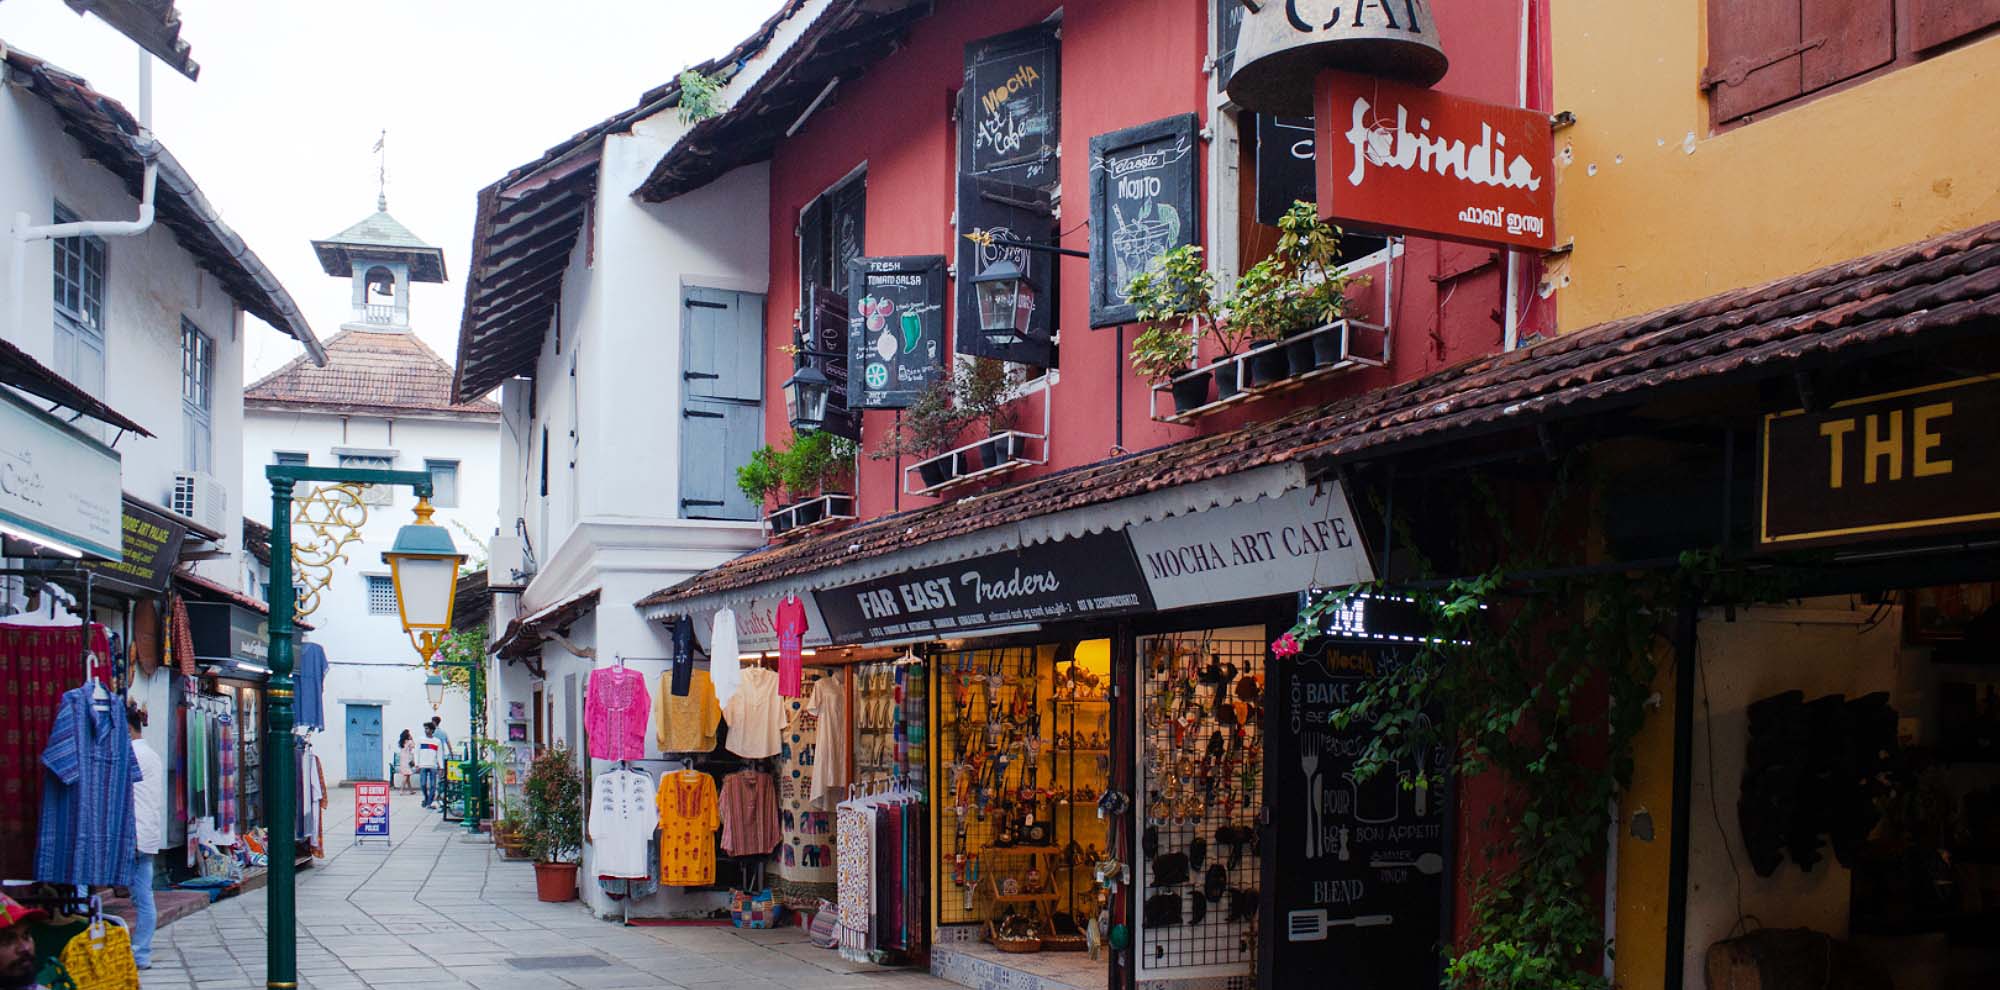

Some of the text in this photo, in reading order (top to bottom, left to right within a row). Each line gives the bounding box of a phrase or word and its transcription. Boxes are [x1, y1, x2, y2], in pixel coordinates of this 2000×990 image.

[982, 65, 1039, 113] MOCHA
[1345, 97, 1541, 191] fabindia
[1118, 176, 1160, 199] MOJITO
[1458, 206, 1504, 227] ഫാബ്
[867, 275, 922, 286] TOMATO SALSA
[870, 262, 901, 272] FRESH
[1820, 401, 1953, 488] THE
[1146, 518, 1353, 579] MOCHA ART CAFE
[856, 588, 900, 619] FAR
[898, 577, 957, 613] EAST
[960, 567, 1060, 604] Traders
[1306, 681, 1350, 705] BAKE
[1323, 788, 1350, 816] POUR
[1313, 879, 1364, 908] BLEND
